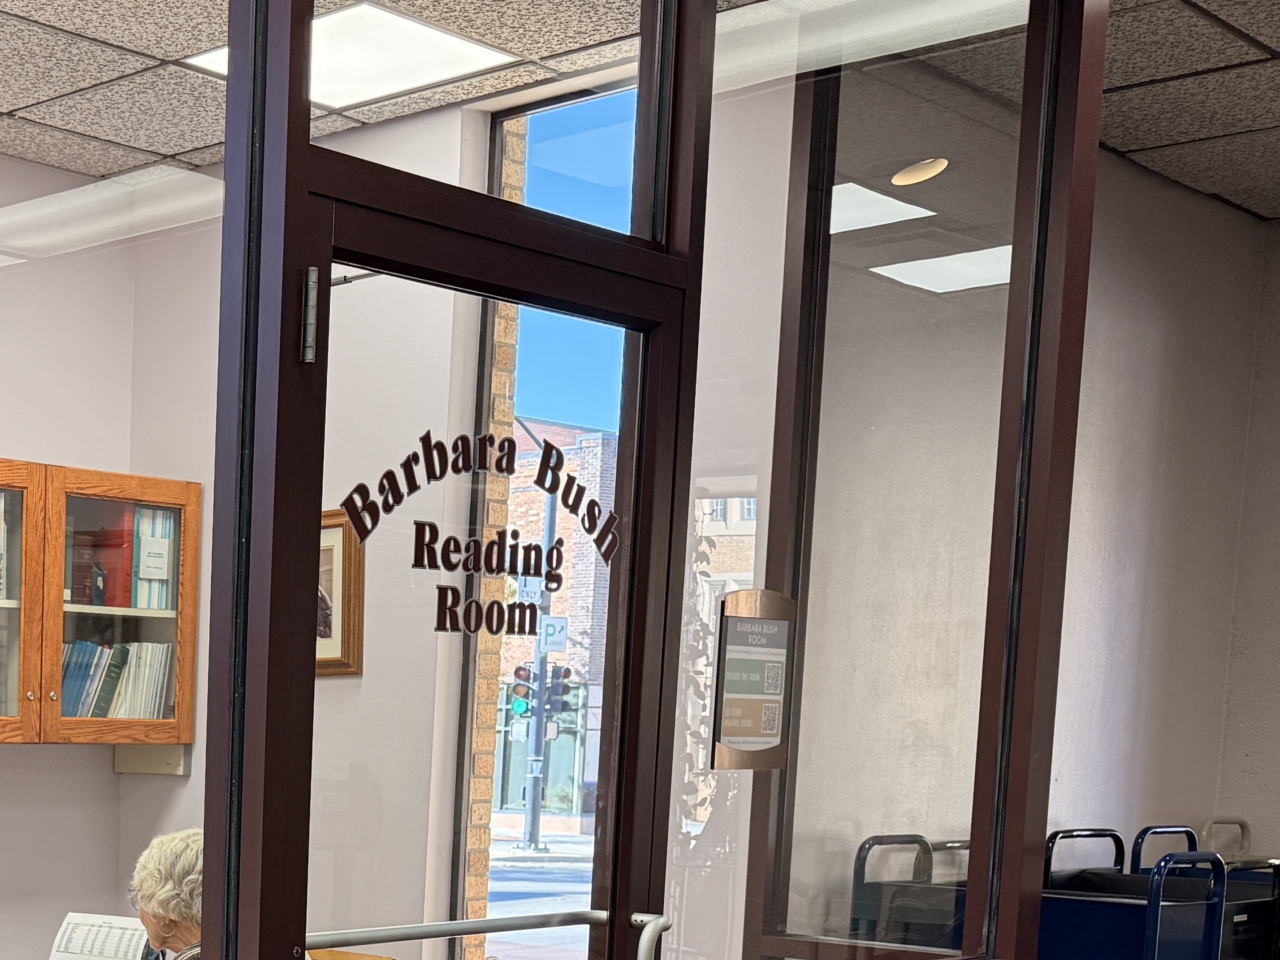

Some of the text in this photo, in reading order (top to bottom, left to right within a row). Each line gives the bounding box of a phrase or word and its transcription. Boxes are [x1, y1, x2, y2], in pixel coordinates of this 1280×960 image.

[340, 429, 620, 567] Barbara Bush
[411, 520, 564, 593] Reading
[434, 584, 539, 636] Room
[737, 622, 778, 634] BARBARA BUSH
[749, 634, 767, 645] ROOM
